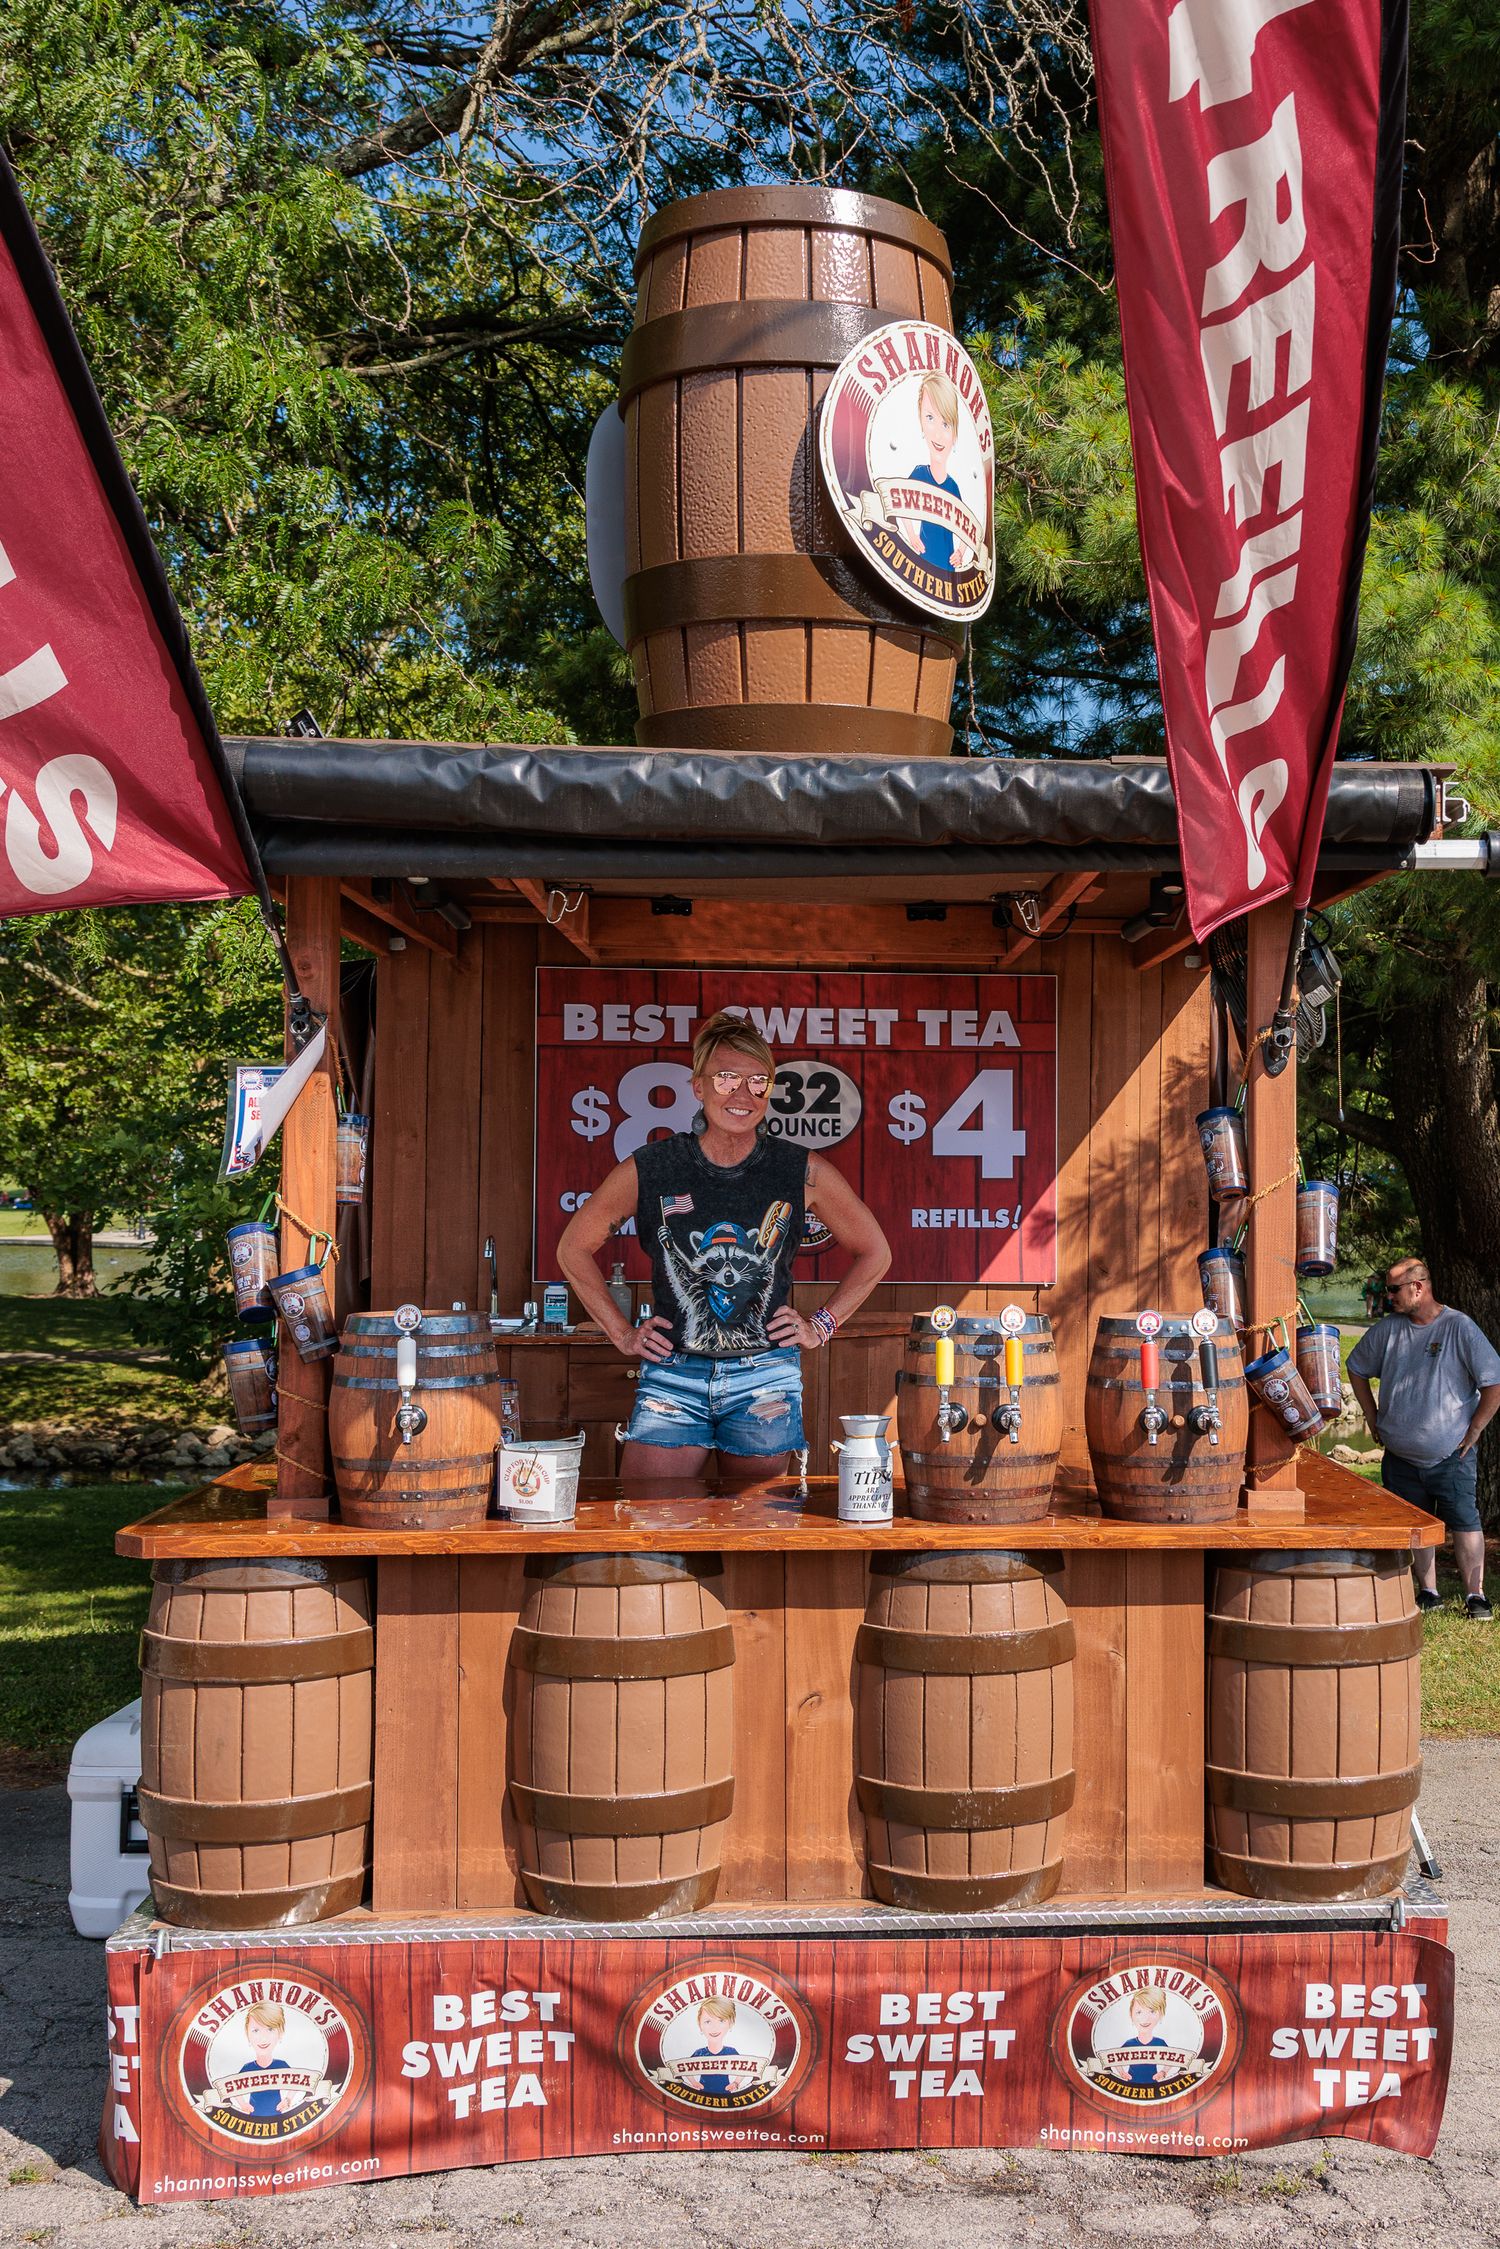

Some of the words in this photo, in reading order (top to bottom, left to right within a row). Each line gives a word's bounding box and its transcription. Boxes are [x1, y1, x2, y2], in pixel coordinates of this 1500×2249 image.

[857, 331, 991, 452] SHANNON'S
[890, 488, 952, 520] SWEET
[954, 506, 977, 545] TEA
[873, 531, 953, 602] SOUTHERN
[956, 571, 985, 603] STYLE
[563, 1003, 698, 1043] BEST
[719, 1005, 899, 1046] WEET
[917, 1009, 1021, 1047] TEA
[770, 1071, 841, 1115] 32
[768, 1117, 841, 1137] OUNCE
[887, 1069, 1026, 1179] $4
[911, 1204, 1022, 1230] REFILLS!
[197, 1981, 338, 2033] SHANNON'S
[653, 1974, 787, 2022] SHANNON'S
[879, 1990, 1005, 2026] BEST
[1087, 1968, 1215, 2011] SHANNON'S
[1304, 1982, 1427, 2019] BEST
[433, 1990, 561, 2031] BEST
[400, 2030, 576, 2079] SWEET
[844, 2029, 1016, 2063] SWEET
[1107, 2051, 1157, 2064] SWEET
[1159, 2051, 1185, 2064] TEA
[1269, 2026, 1438, 2063] SWEET
[224, 2074, 279, 2094] SWEET
[281, 2073, 311, 2087] TEA
[677, 2060, 728, 2073] SWEET
[730, 2060, 758, 2072] TEA
[889, 2069, 985, 2099] TEA
[448, 2074, 548, 2120] TEA
[666, 2082, 728, 2107] SOUTHERN
[733, 2084, 770, 2107] STYLE
[1094, 2074, 1155, 2099] SOUTHERN
[1160, 2074, 1196, 2097] STYLE
[1312, 2068, 1402, 2108] TEA
[213, 2108, 278, 2137] SOUTHERN
[282, 2101, 323, 2133] STYLE
[612, 2127, 825, 2144] shannonssweettea.com
[1039, 2123, 1249, 2148] shannonssweettea.com
[153, 2156, 381, 2194] shannonssweettea.com
